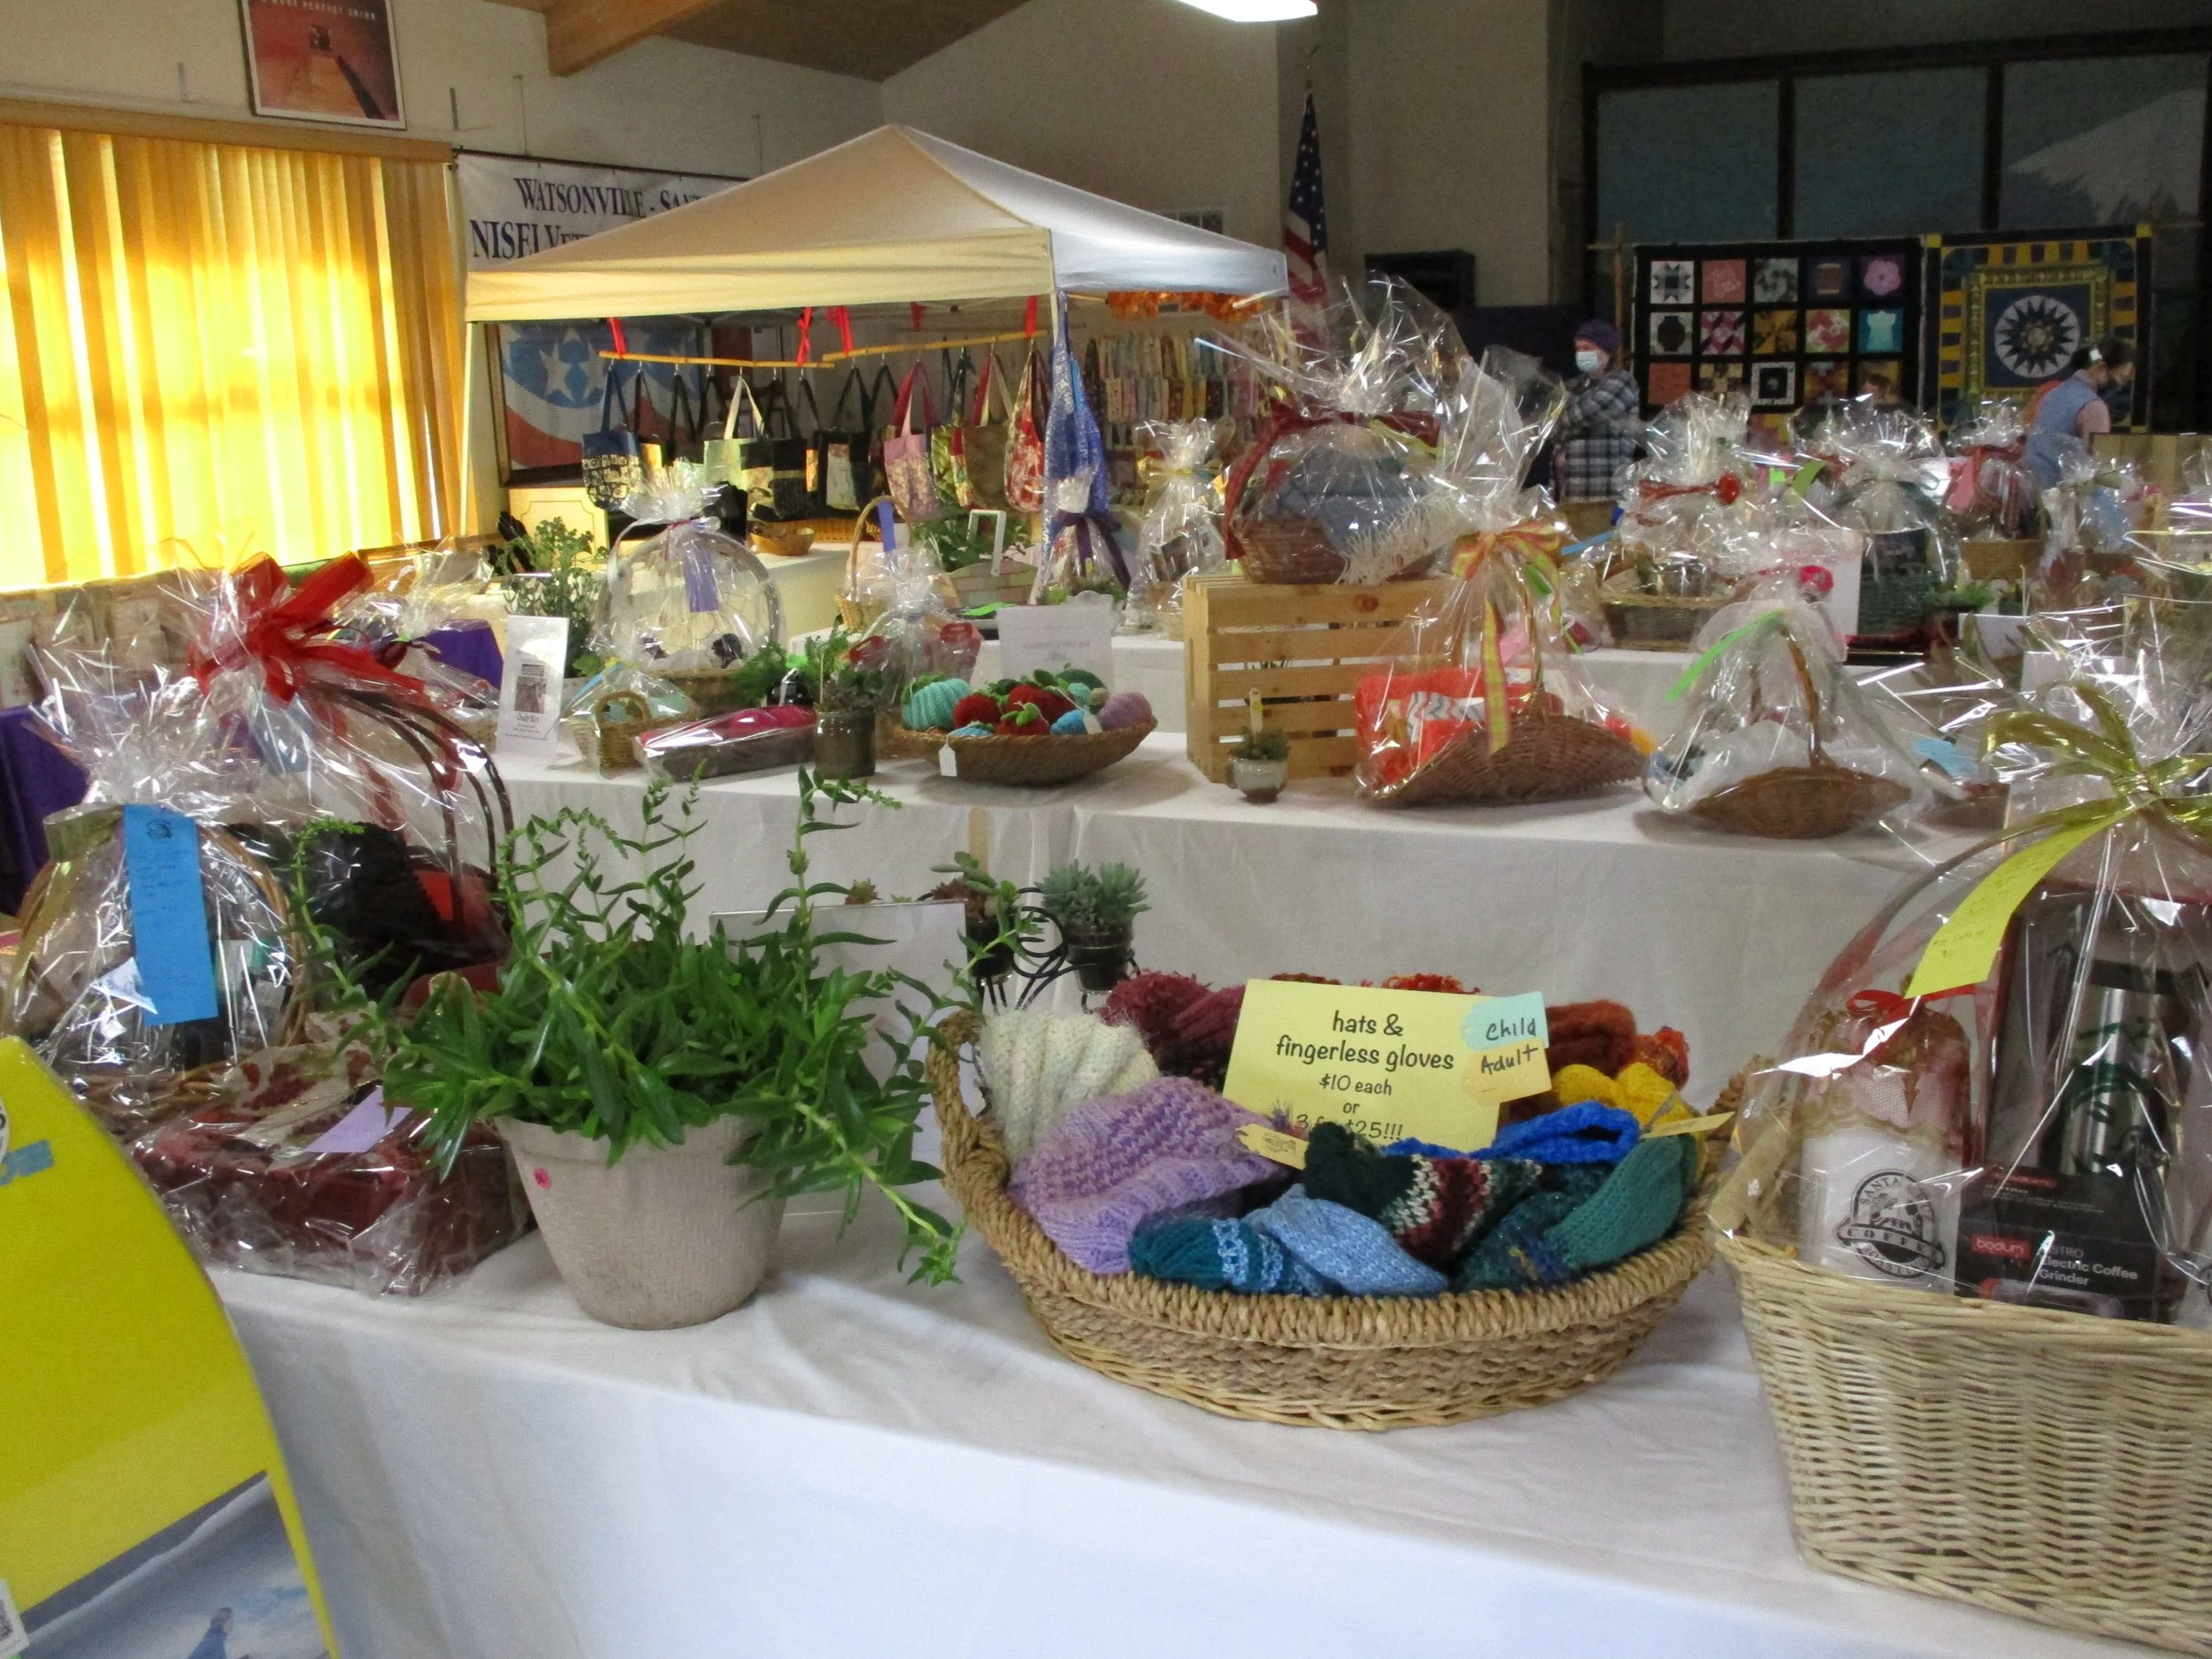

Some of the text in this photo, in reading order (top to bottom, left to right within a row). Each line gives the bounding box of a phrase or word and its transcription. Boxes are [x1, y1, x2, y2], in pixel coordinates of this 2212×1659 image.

[1332, 1010, 1404, 1037] hats &
[1486, 1017, 1537, 1041] Child
[1276, 1034, 1455, 1072] fingerless gloves
[1480, 1043, 1539, 1076] Adult
[1319, 1072, 1393, 1096] $10 each
[1342, 1102, 1360, 1114] or
[2038, 1268, 2091, 1286] Grinder
[2092, 1263, 2139, 1280] Coffee
